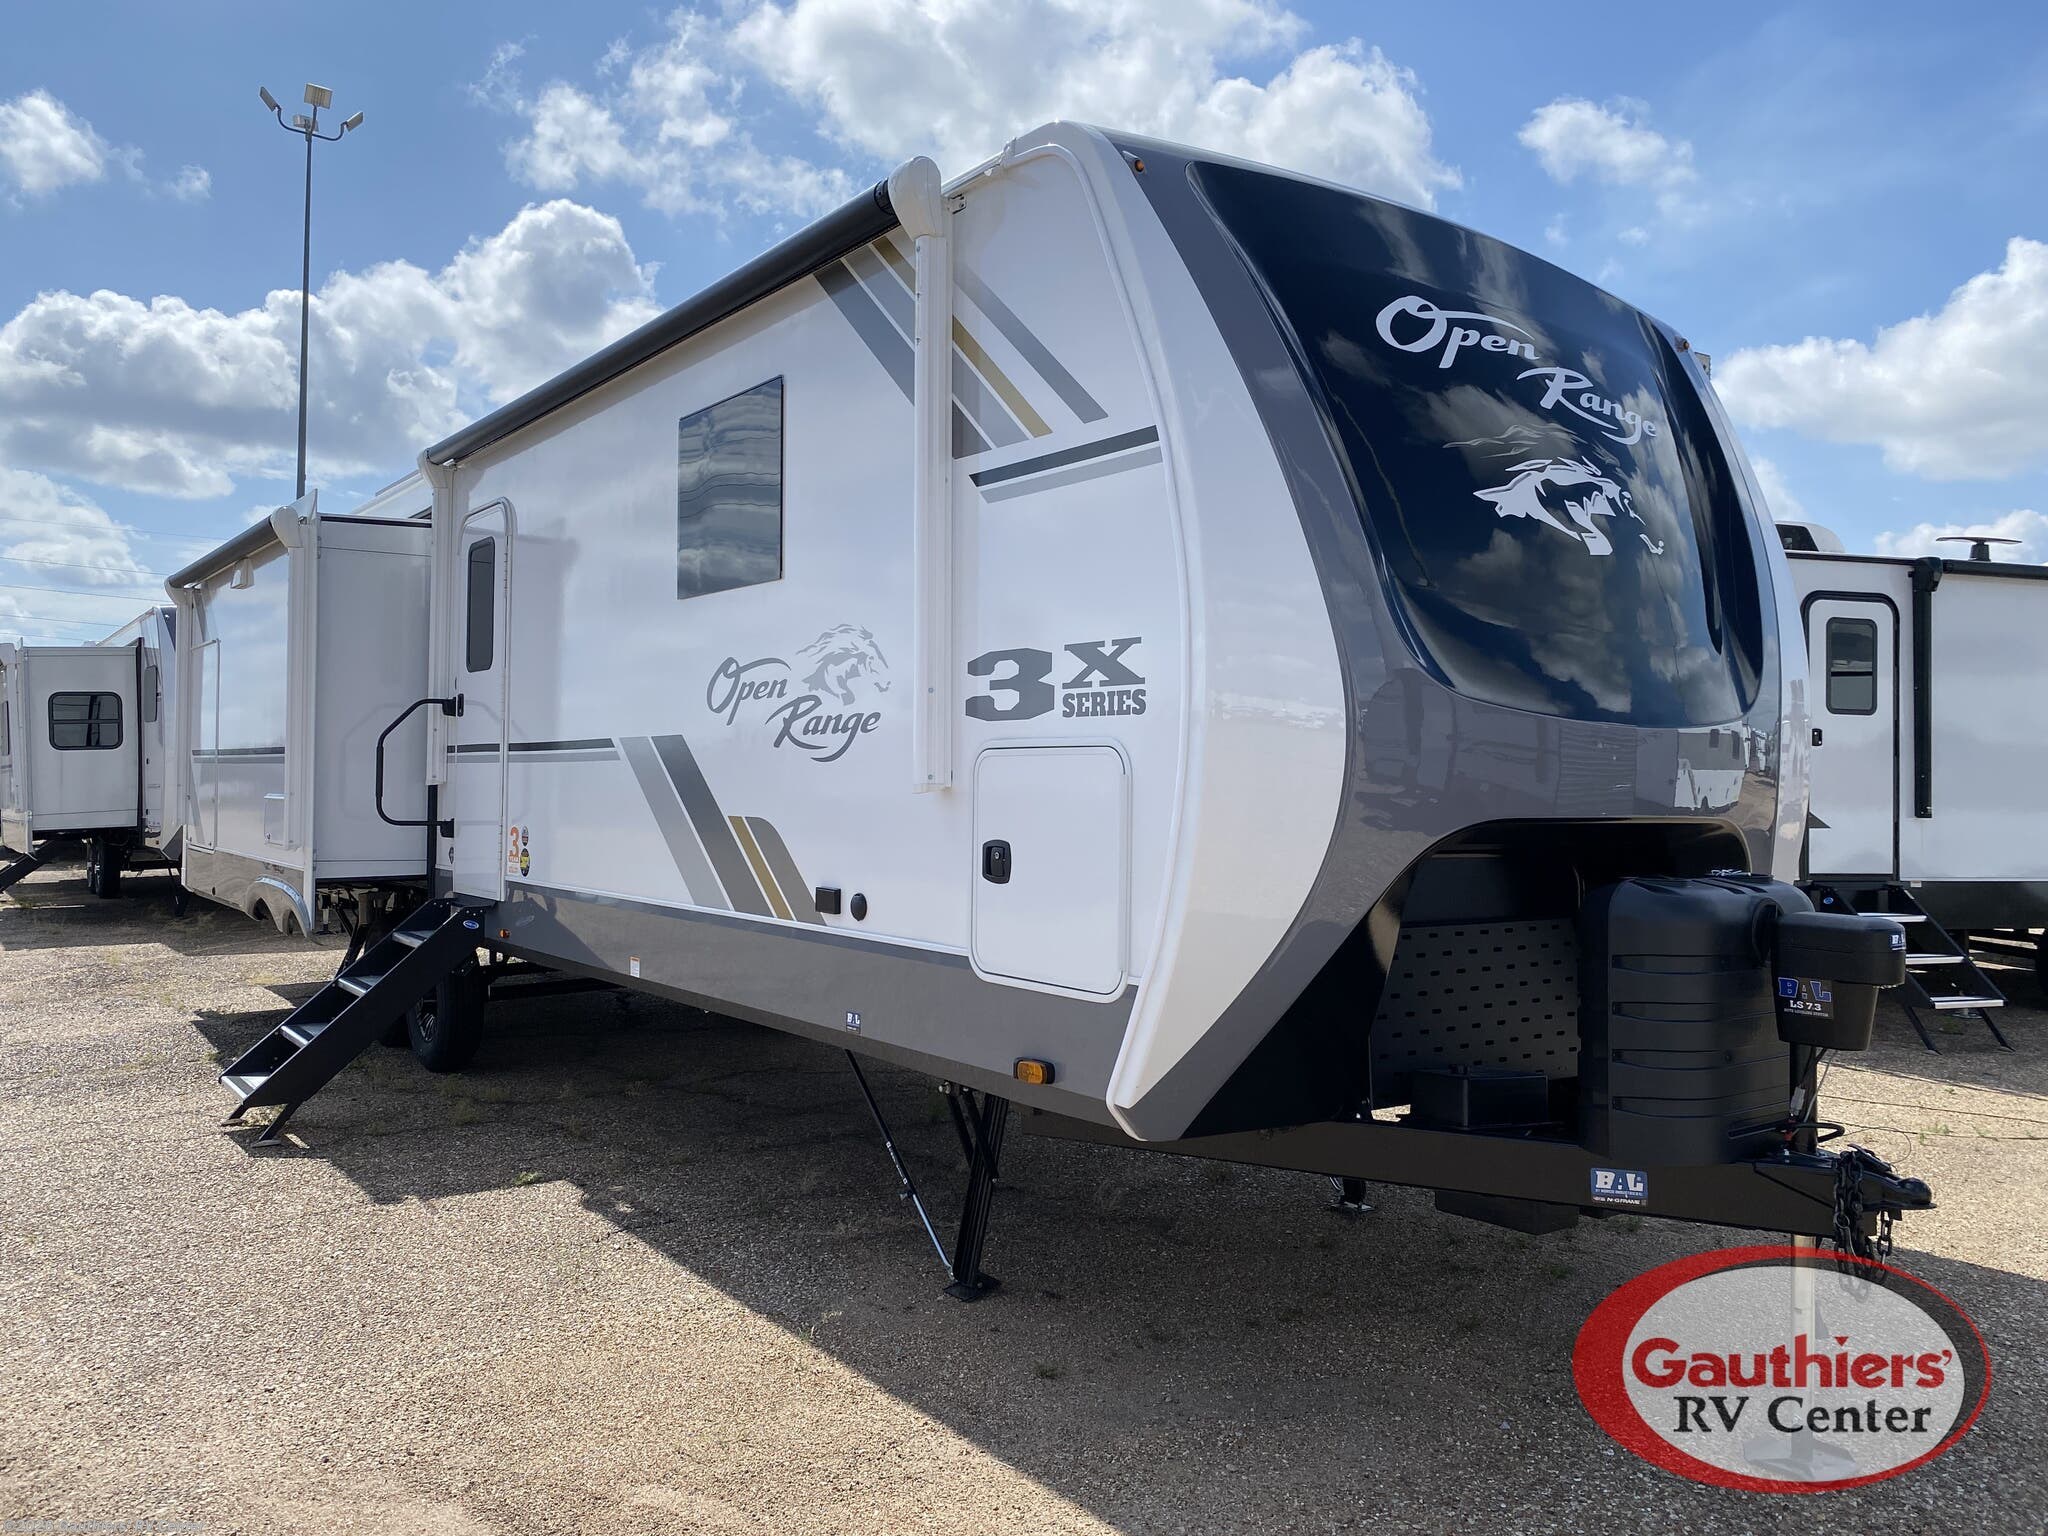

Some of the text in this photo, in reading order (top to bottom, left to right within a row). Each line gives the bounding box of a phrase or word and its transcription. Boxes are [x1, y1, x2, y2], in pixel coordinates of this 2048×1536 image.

[1376, 295, 1540, 368] Open
[1517, 366, 1657, 445] Range
[706, 656, 792, 726] Open
[1062, 688, 1147, 718] SERIES
[765, 694, 881, 762] Range
[1790, 1000, 1804, 1009] LS
